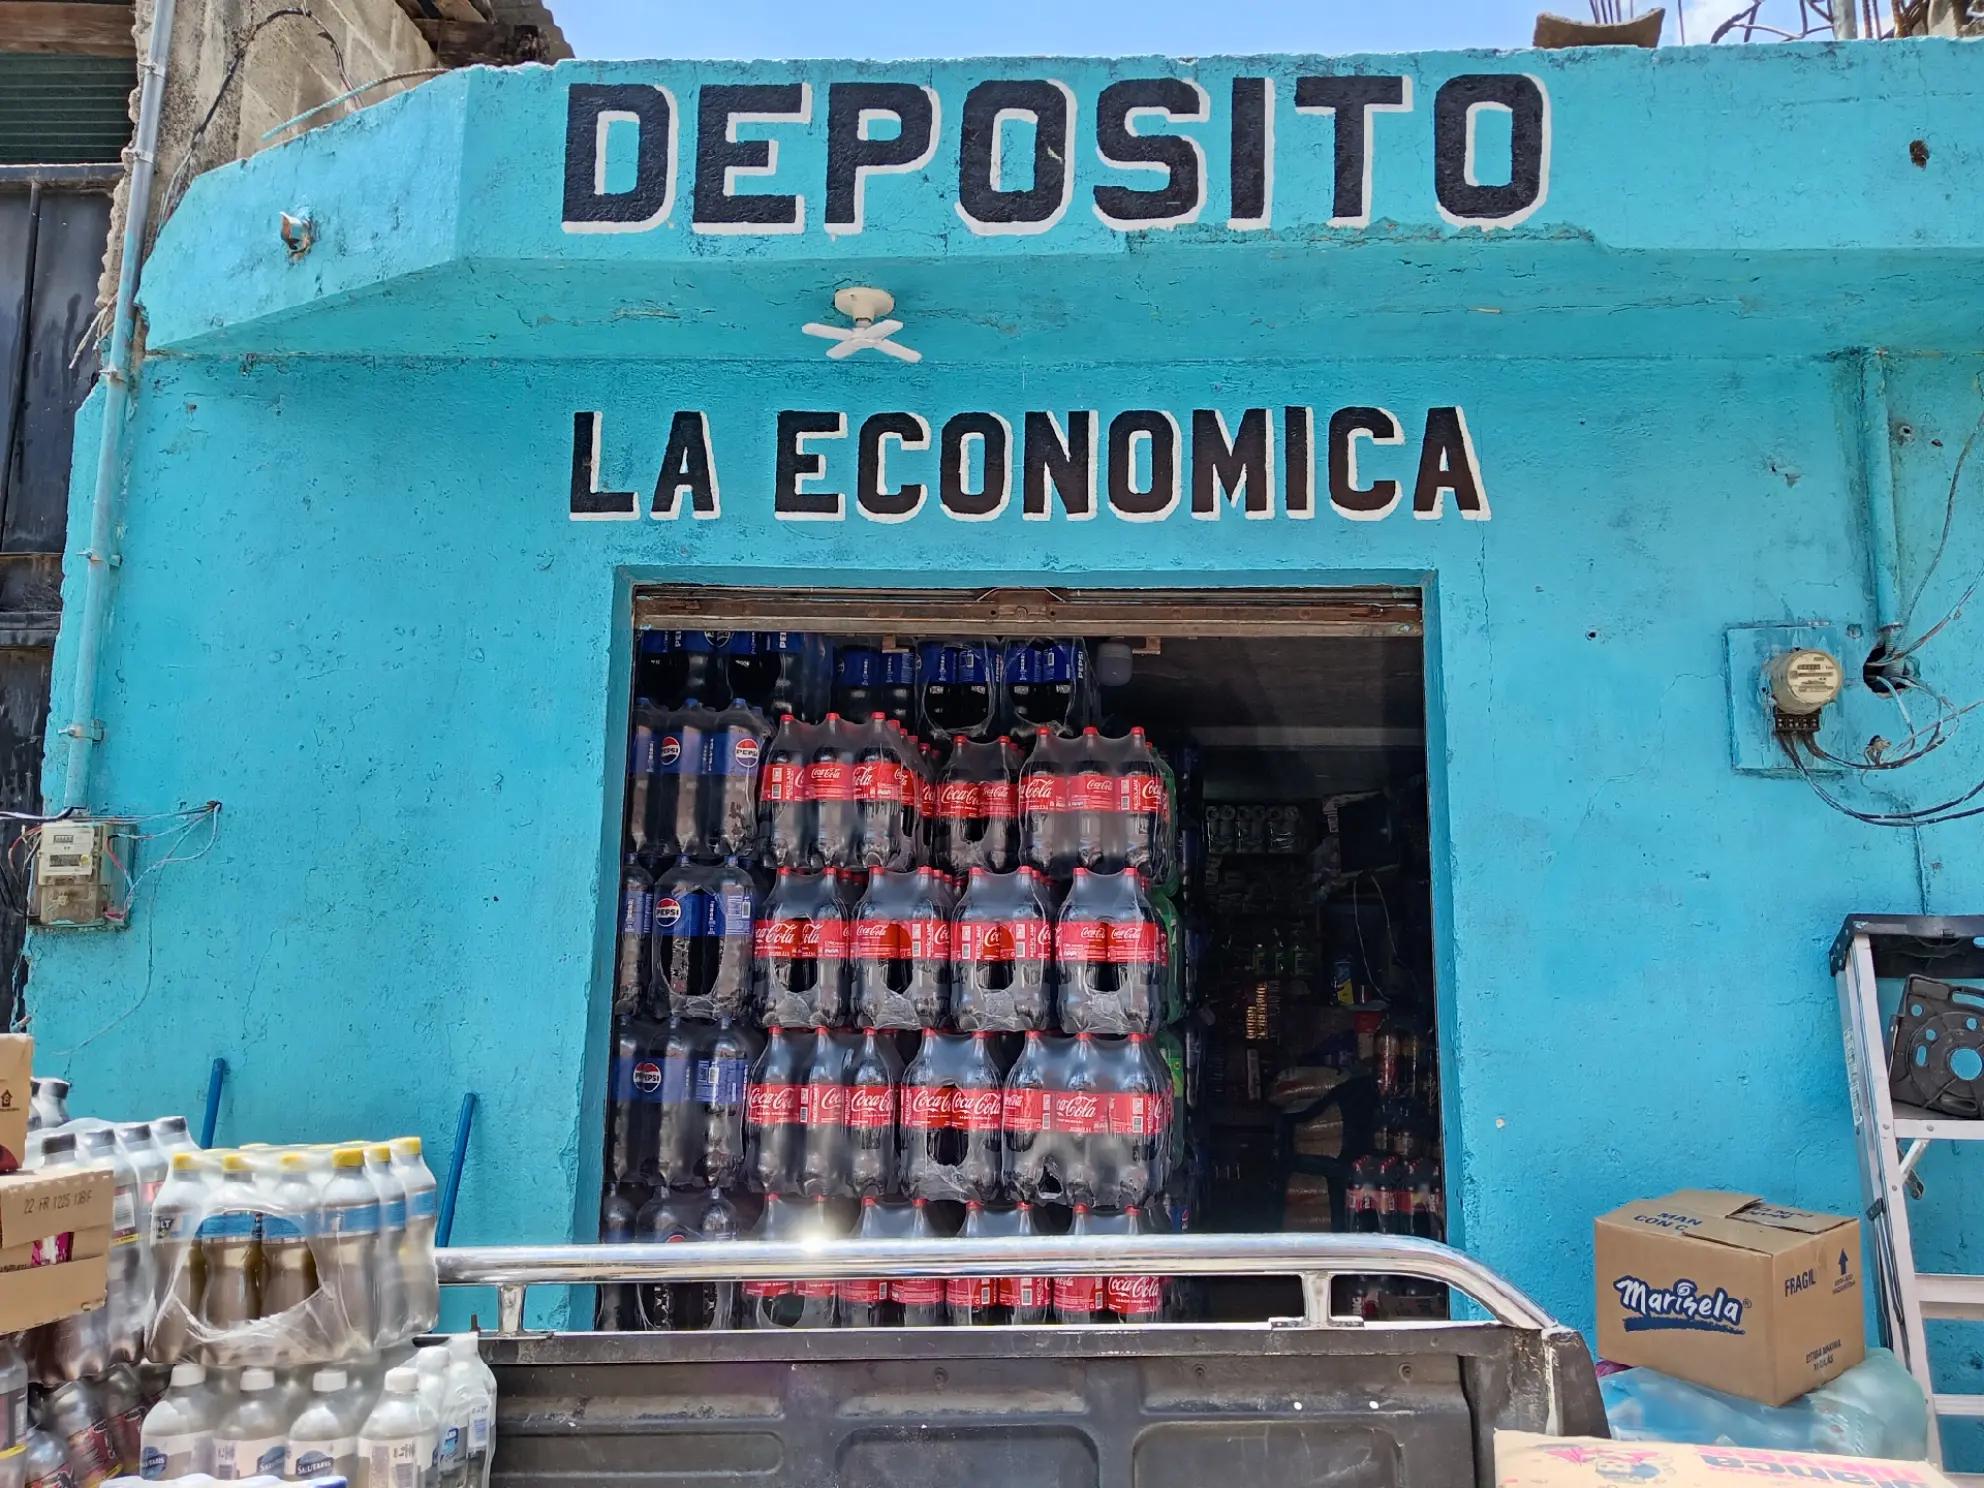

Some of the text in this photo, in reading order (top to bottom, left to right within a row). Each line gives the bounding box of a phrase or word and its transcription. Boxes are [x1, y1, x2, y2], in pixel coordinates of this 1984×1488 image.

[560, 73, 1551, 238] DEPOSITO
[570, 405, 1491, 523] LA ECONOMICA
[656, 908, 679, 916] PEPSI
[1634, 1215, 1673, 1227] CON
[1658, 1212, 1703, 1226] MAN
[1784, 1268, 1816, 1298] FRAGIL
[1613, 1275, 1745, 1326] Marisela
